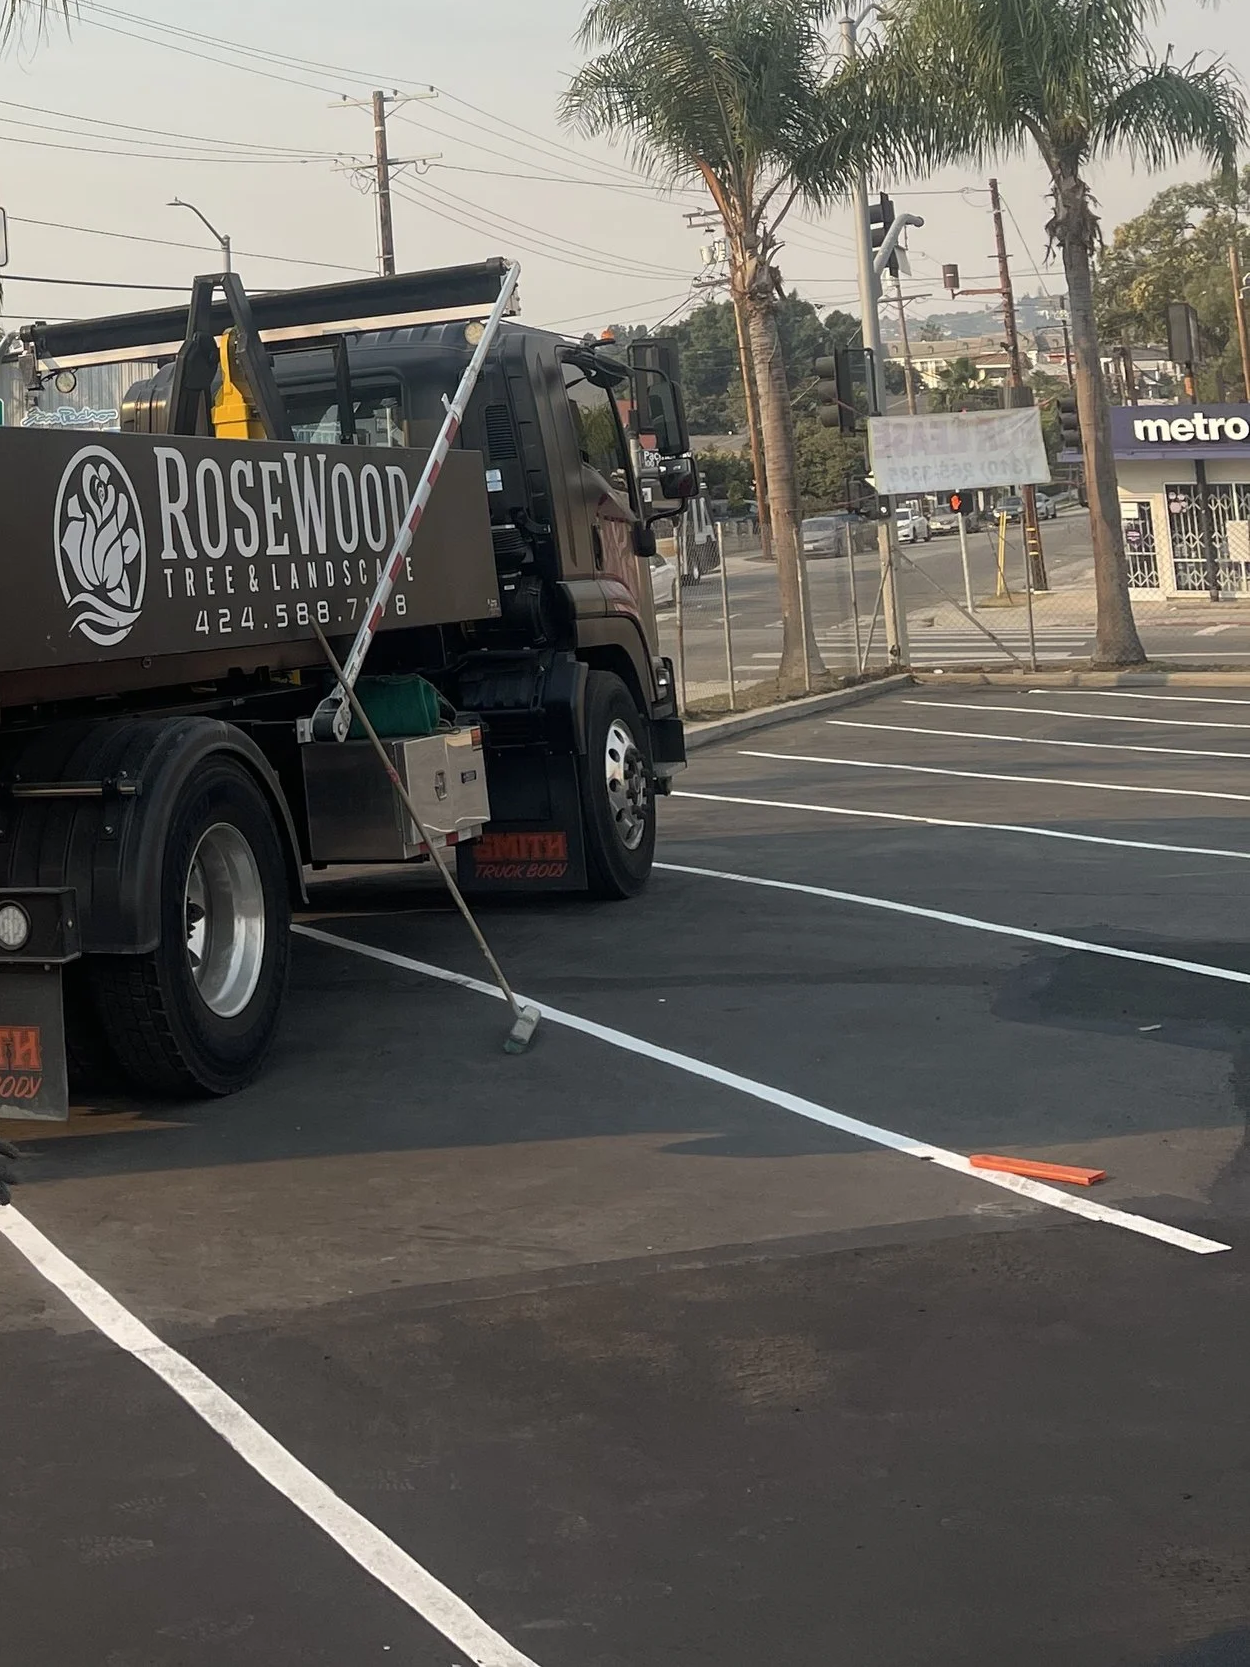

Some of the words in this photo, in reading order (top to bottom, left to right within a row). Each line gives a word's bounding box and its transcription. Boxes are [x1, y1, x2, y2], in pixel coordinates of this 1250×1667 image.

[1134, 412, 1250, 442] metro
[153, 446, 413, 559] ROSEWOOD
[163, 566, 235, 598] TREE
[248, 564, 259, 593] &
[271, 557, 414, 591] LANDSCAE
[195, 594, 407, 635] 424.588.718
[472, 831, 568, 862] SMITH
[475, 864, 526, 879] TRUCK
[526, 862, 568, 879] BODY
